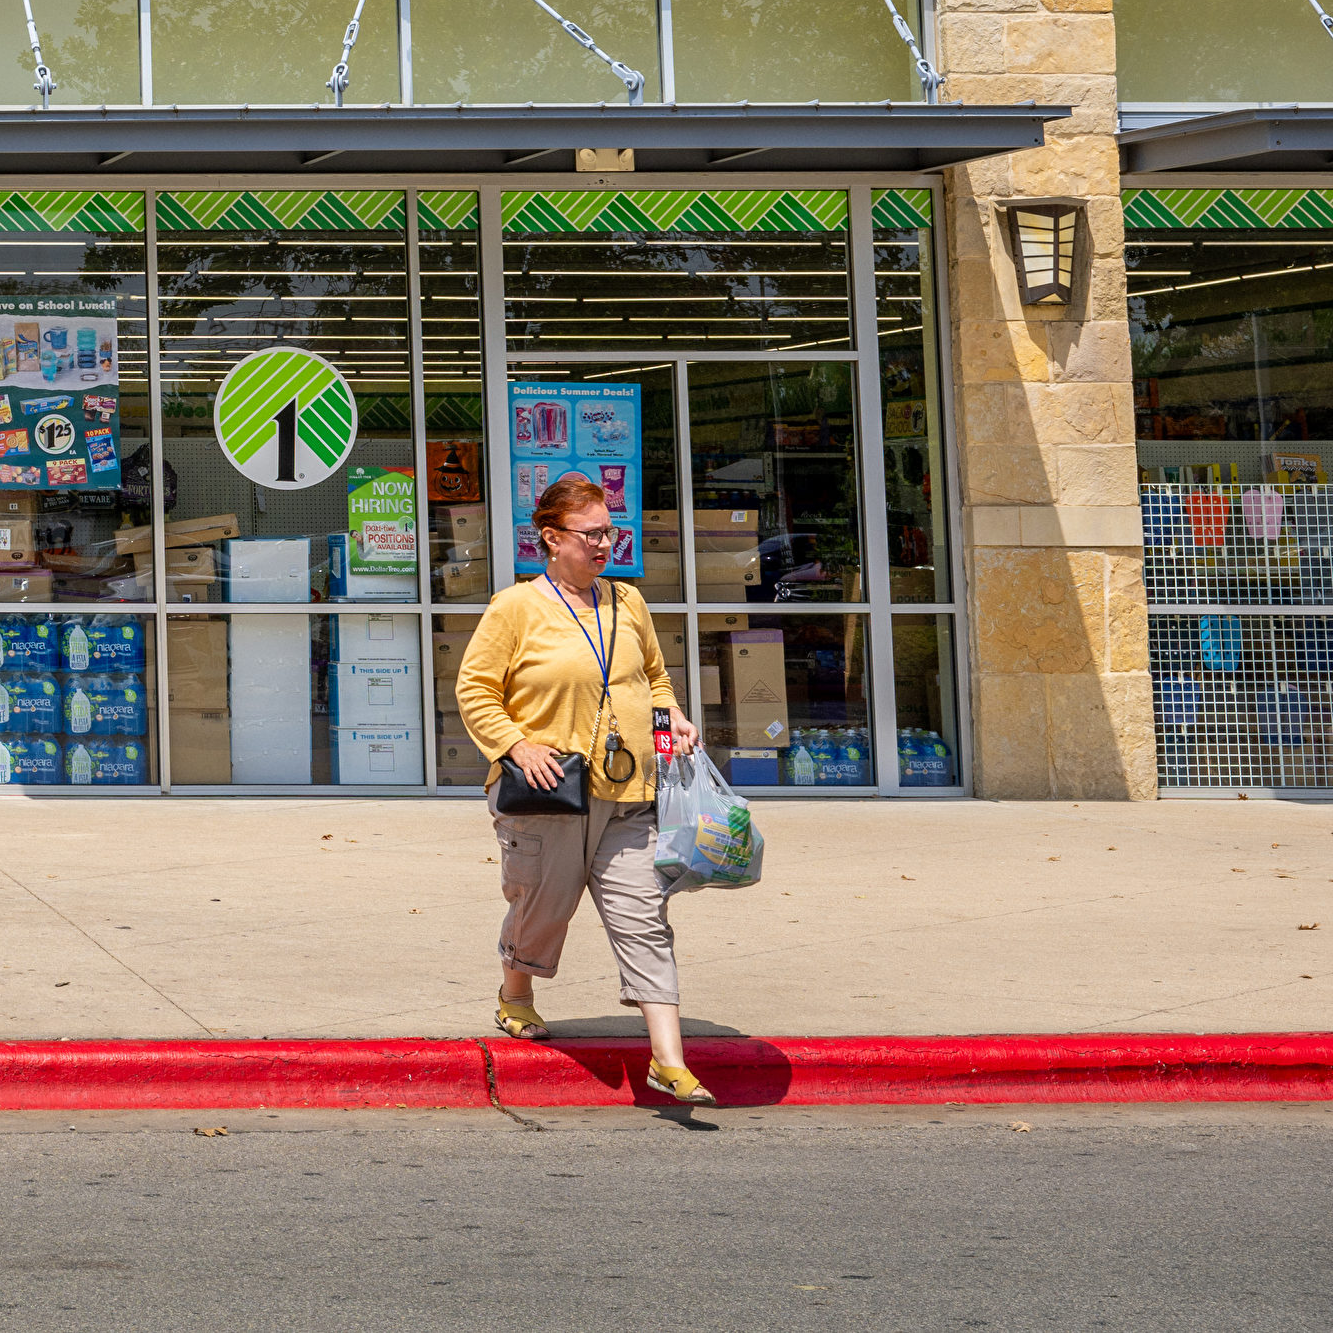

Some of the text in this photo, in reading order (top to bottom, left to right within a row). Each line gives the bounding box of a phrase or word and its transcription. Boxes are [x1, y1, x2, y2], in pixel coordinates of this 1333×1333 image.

[37, 300, 74, 310] School
[78, 300, 116, 310] Lunch!
[513, 387, 634, 396] Delicious Summer Deals!
[1276, 457, 1317, 467] Tonka
[373, 482, 413, 496] NOW
[351, 499, 413, 514] HIRING
[365, 525, 397, 534] part-time
[368, 534, 415, 543] POSITIONS
[11, 641, 46, 651] niagara
[97, 642, 131, 652] niagara
[17, 697, 51, 707] niagara
[99, 705, 133, 715] niagara
[660, 734, 671, 749] 22
[18, 757, 52, 767] niagara
[100, 762, 134, 772] niagara
[909, 760, 943, 769] niagara
[822, 762, 857, 773] niagara
